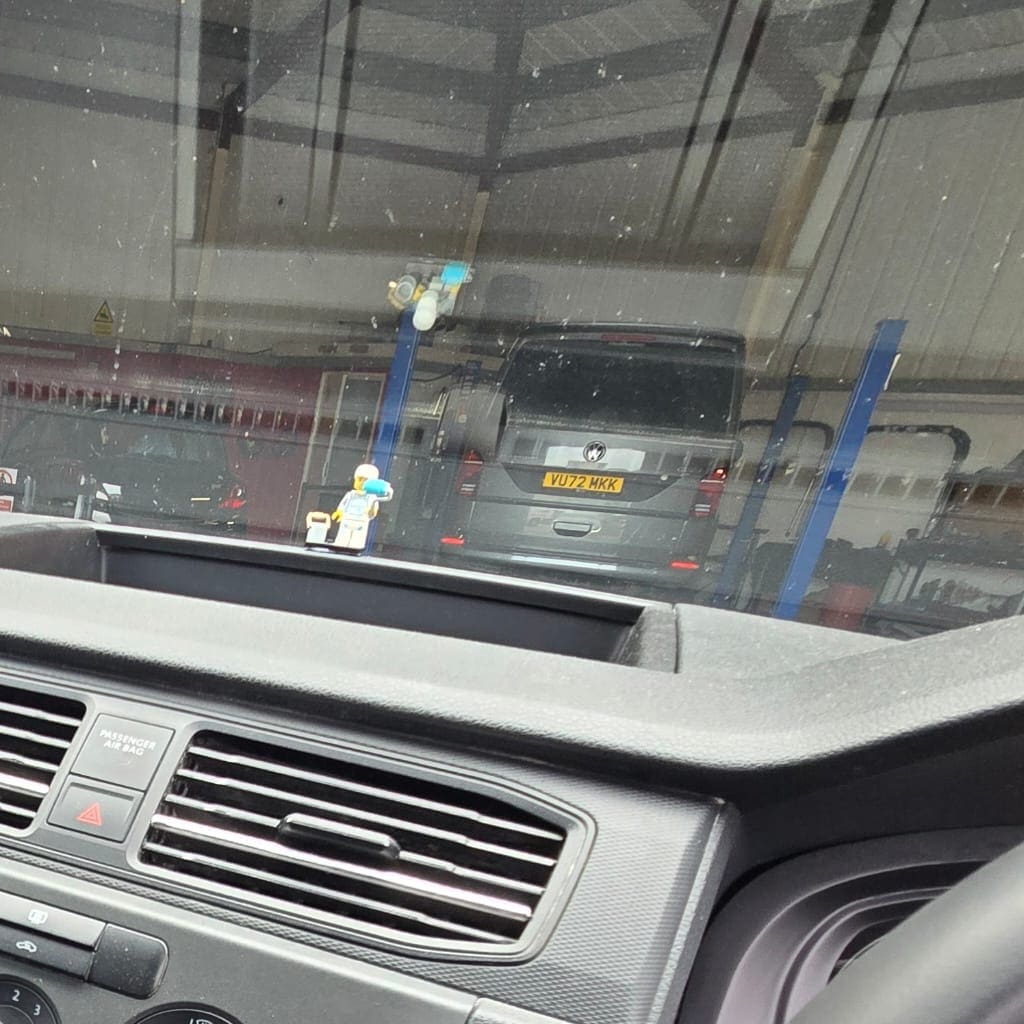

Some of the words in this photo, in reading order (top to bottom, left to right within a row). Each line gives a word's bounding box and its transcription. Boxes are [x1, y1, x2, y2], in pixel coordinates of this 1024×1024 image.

[551, 473, 587, 488] VU72
[589, 477, 619, 491] MKK
[99, 729, 157, 751] PASSENGER
[103, 740, 121, 751] AIR
[122, 744, 145, 756] BAG
[12, 989, 21, 1002] 2
[33, 1004, 41, 1016] 3
